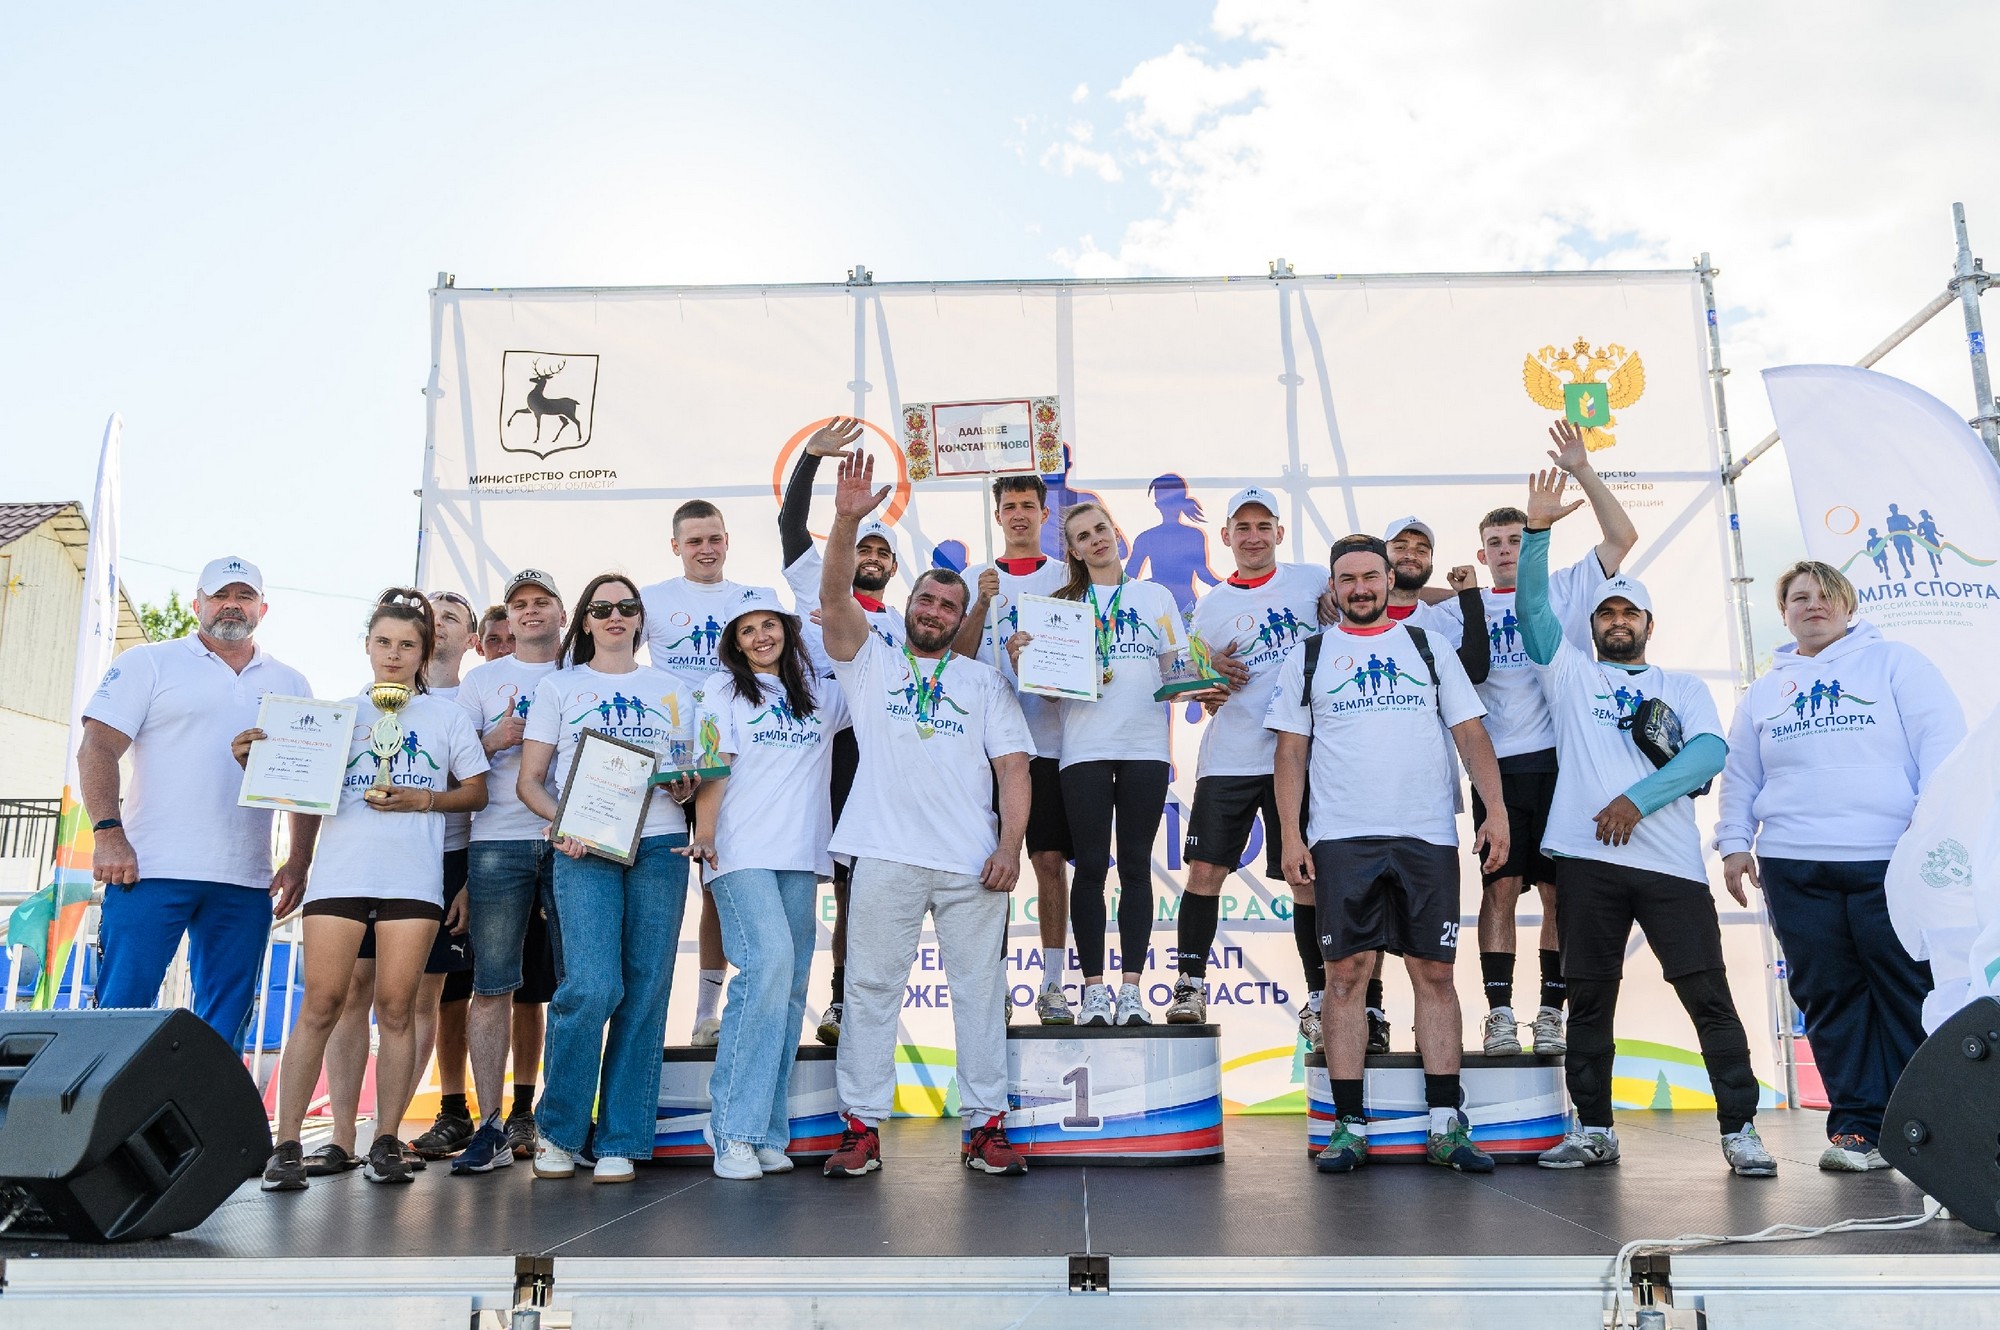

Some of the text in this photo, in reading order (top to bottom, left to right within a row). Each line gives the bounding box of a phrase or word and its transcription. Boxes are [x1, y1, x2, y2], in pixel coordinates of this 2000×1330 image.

[958, 425, 1008, 437] ДАЛЬНЕЕ
[938, 440, 1030, 453] КОНСТАНТИНОВО
[469, 469, 618, 485] МИНИСТЕРСТВО СПОРТА
[470, 480, 615, 494] НИЖЕГОРОДСКОЙ ОБЛАСТИ
[1858, 581, 2000, 604] МЛЯ СПОРТА
[1942, 601, 1988, 609] МАРАФОН
[667, 656, 706, 666] ЗЕМЛЯ
[1332, 694, 1427, 713] ЗЕМЛЯ СПОРТА
[1771, 714, 1876, 739] ЗЕМЛЯ СПОРТА
[622, 727, 670, 742] СПОРТА
[752, 729, 788, 743] ЗЕМЛЯ
[1440, 921, 1459, 948] 29
[1165, 946, 1243, 970] ЭАП
[1060, 1066, 1101, 1129] 1
